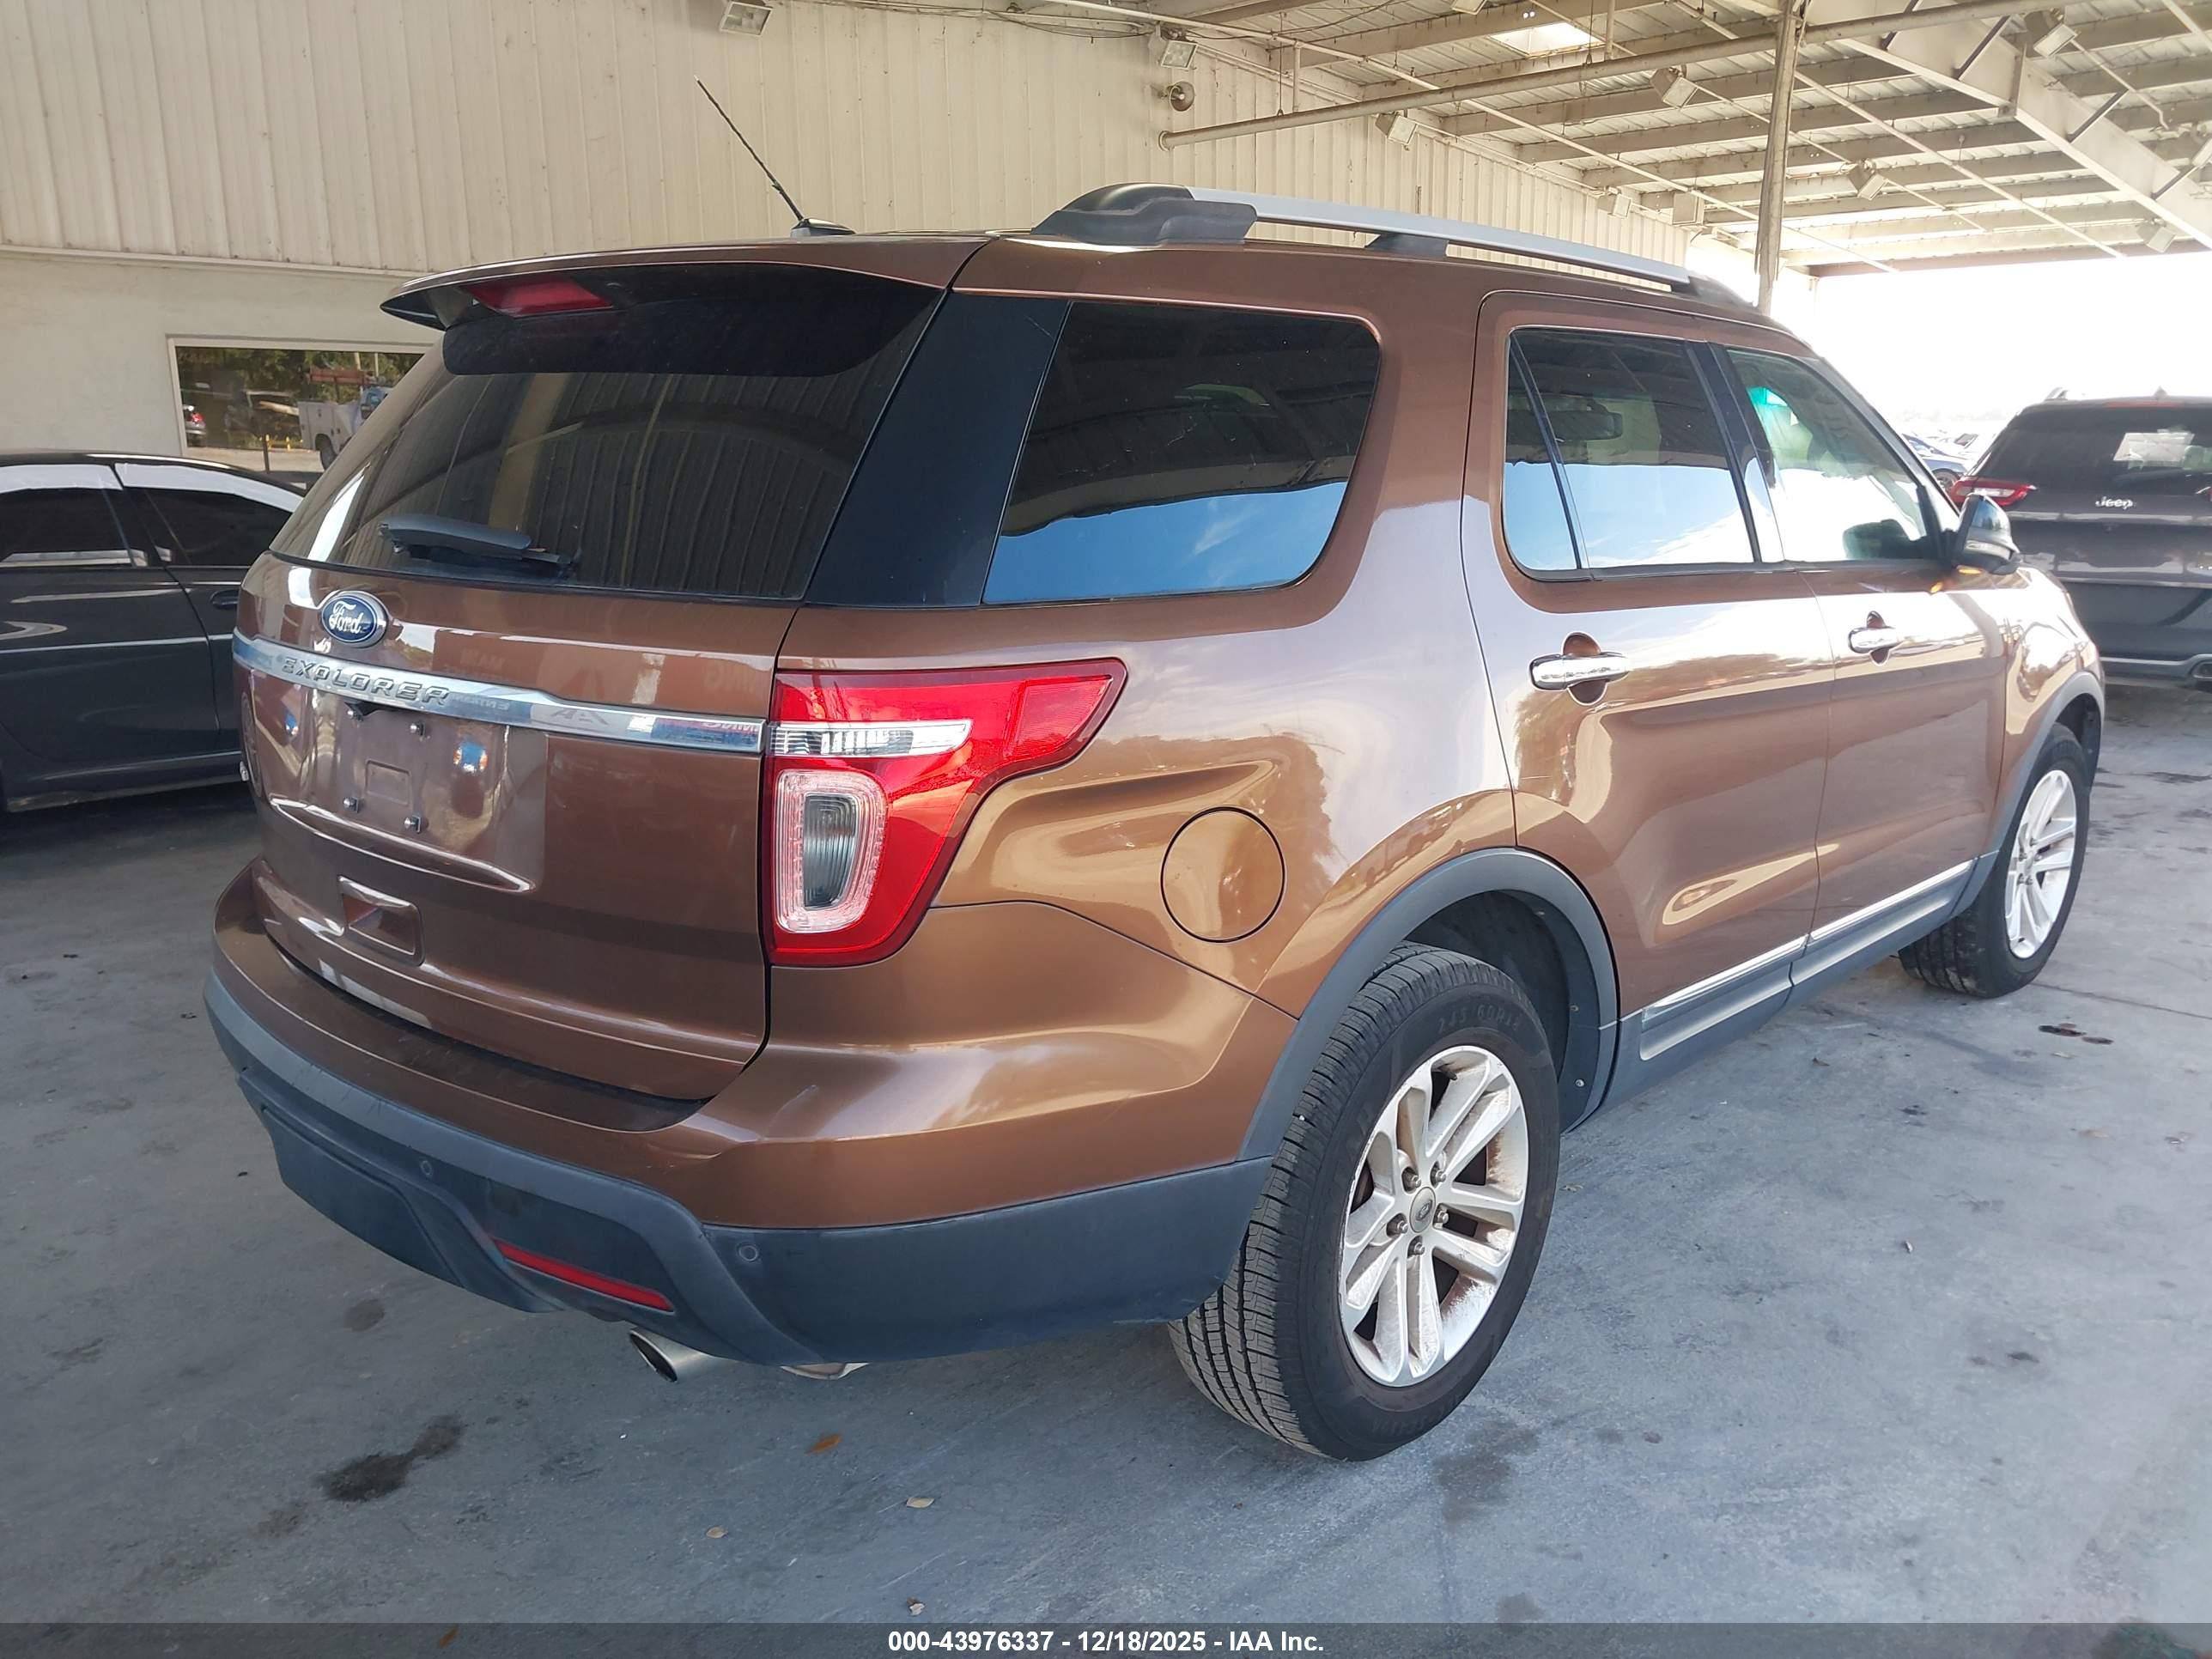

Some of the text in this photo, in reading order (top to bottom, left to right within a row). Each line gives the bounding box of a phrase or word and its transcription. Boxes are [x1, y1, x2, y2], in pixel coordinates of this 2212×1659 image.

[2094, 495, 2134, 510] Jeep
[328, 600, 364, 635] Ford
[281, 655, 451, 706] EXPLORER
